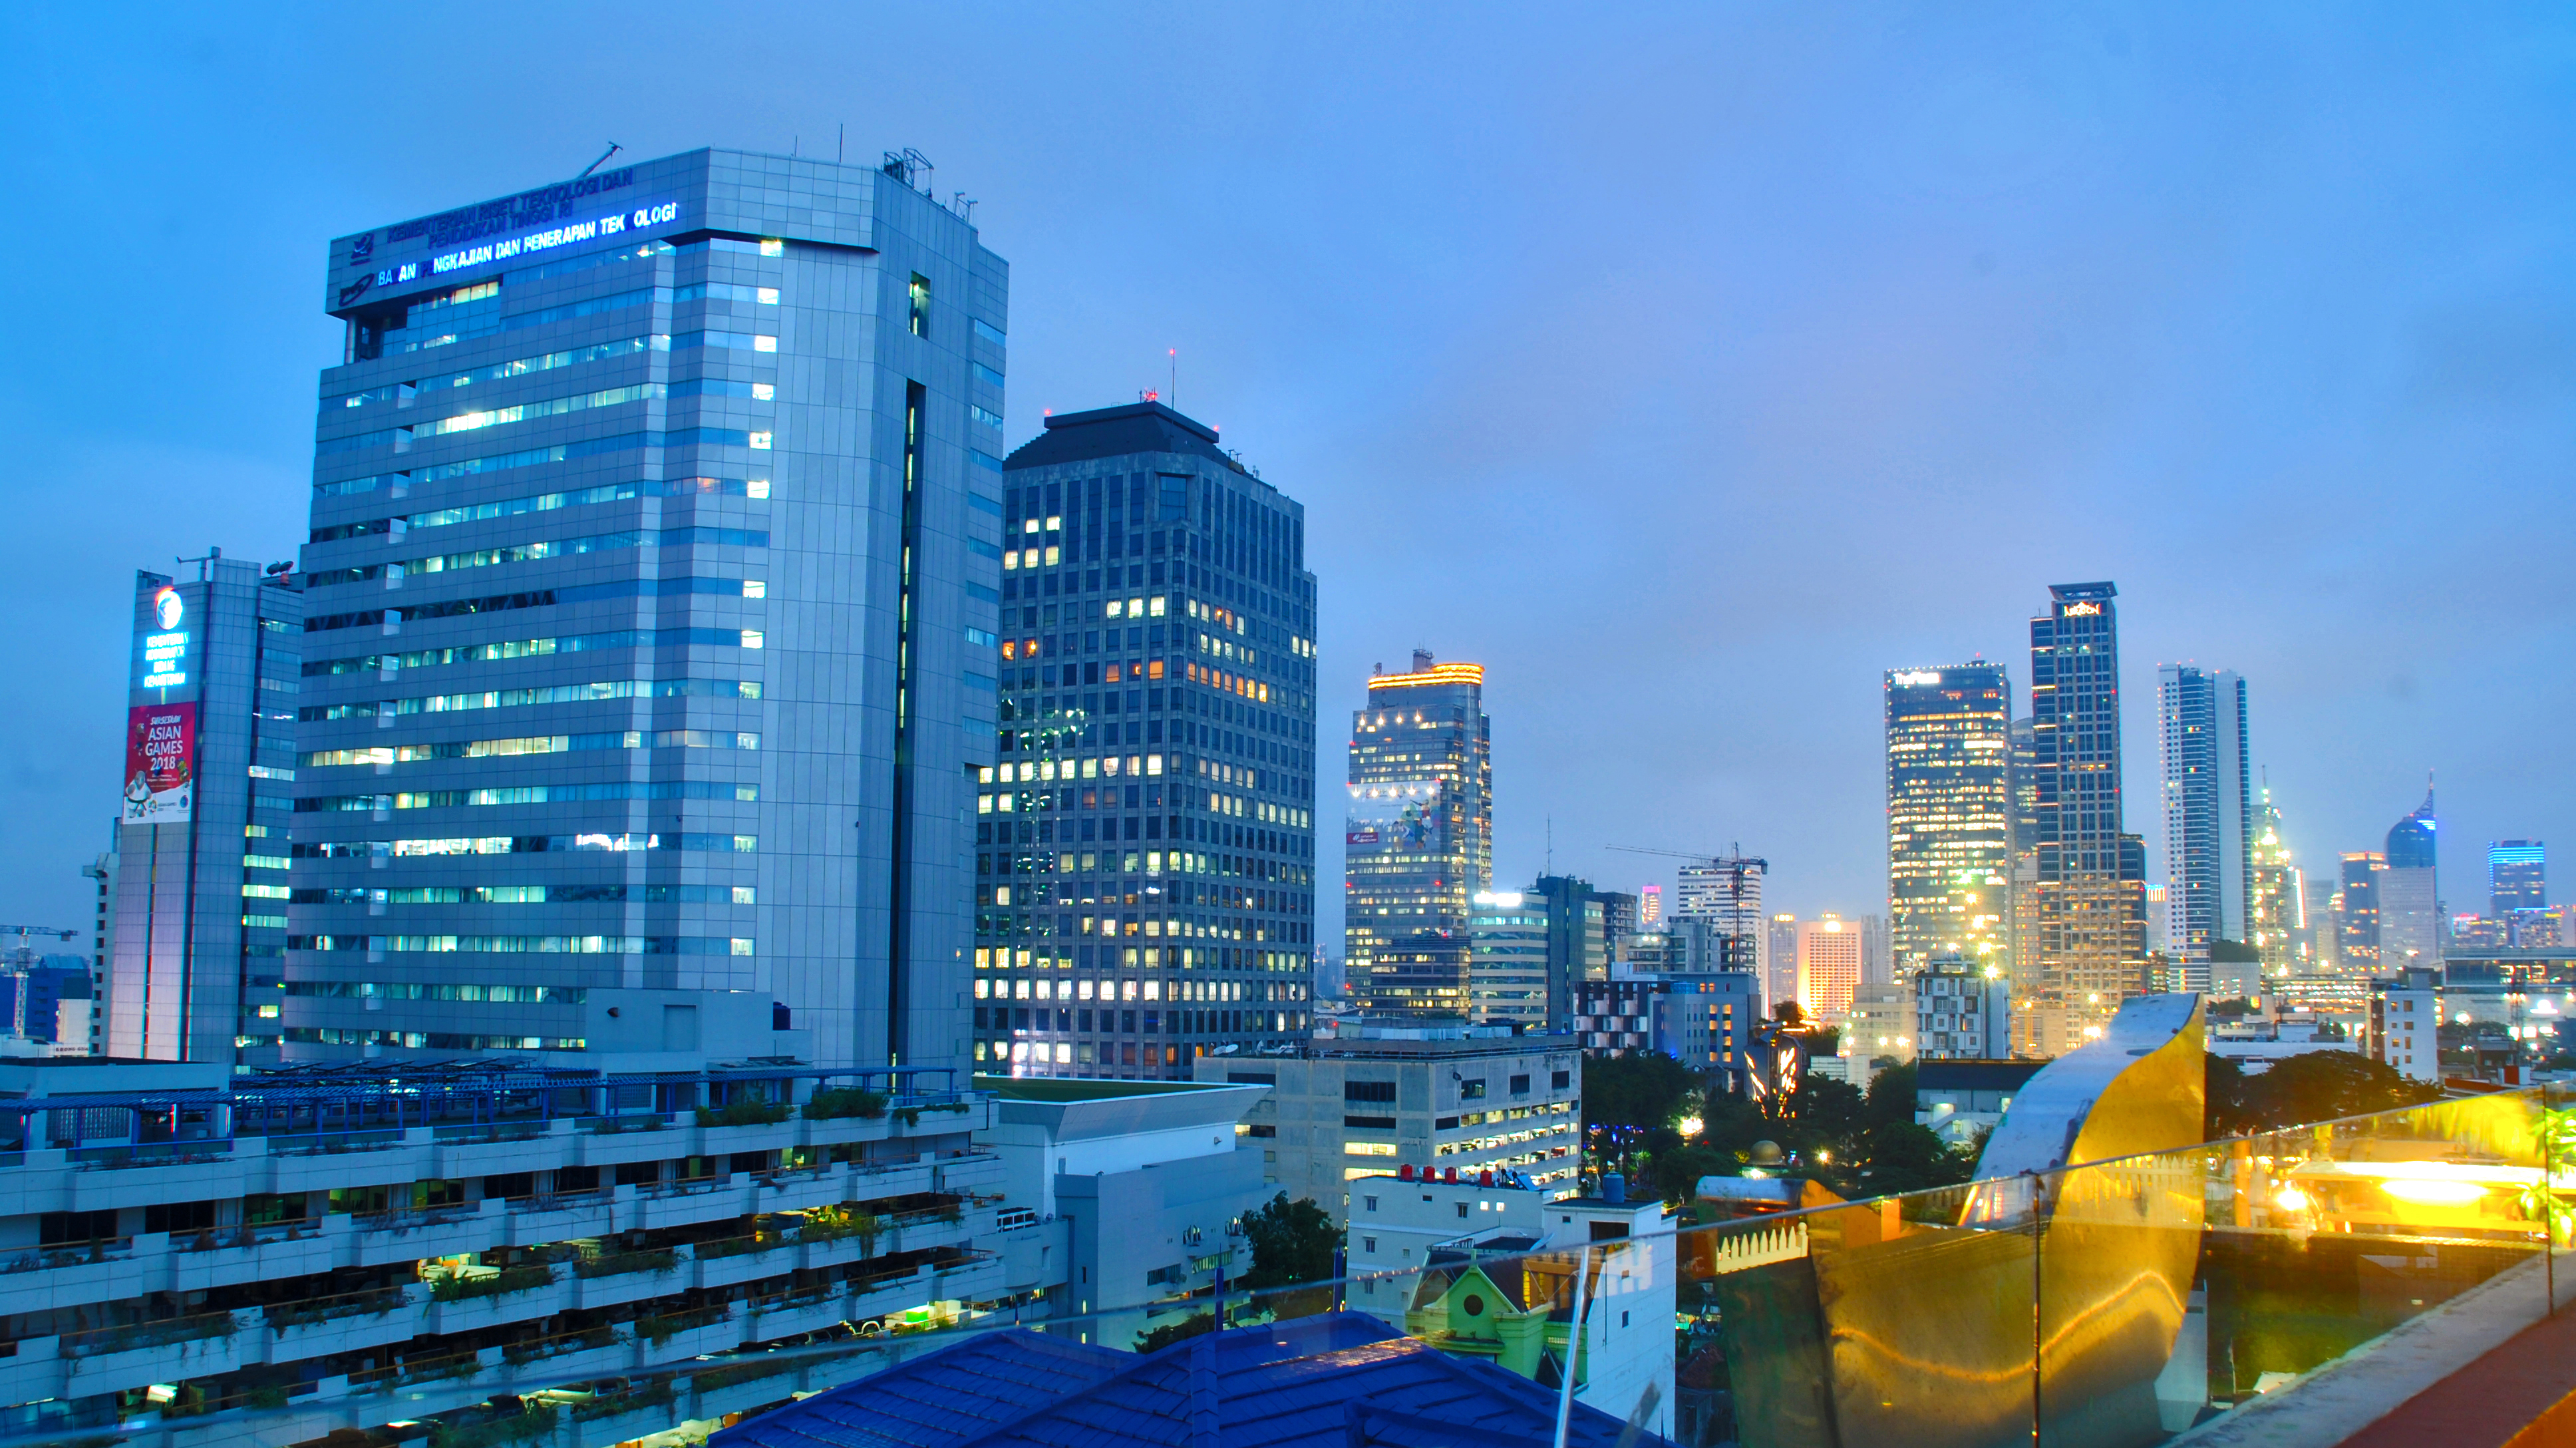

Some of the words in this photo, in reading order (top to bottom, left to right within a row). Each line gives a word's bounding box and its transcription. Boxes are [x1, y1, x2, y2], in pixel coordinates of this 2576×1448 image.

[387, 206, 476, 244] KEMENTERIAN
[478, 196, 518, 222] RISET
[520, 177, 599, 210] TEKNOLOGI
[601, 168, 633, 192] DAN
[427, 215, 507, 250] PENDIDIKAN
[510, 204, 554, 230] TINGGI
[558, 201, 573, 218] RI
[495, 238, 522, 260] DAN
[523, 220, 596, 254] PENERAPAN
[600, 202, 677, 236] TEKNOLOGI
[145, 740, 183, 757] GAMES
[148, 725, 182, 741] ASIAN
[150, 756, 176, 771] 2018
